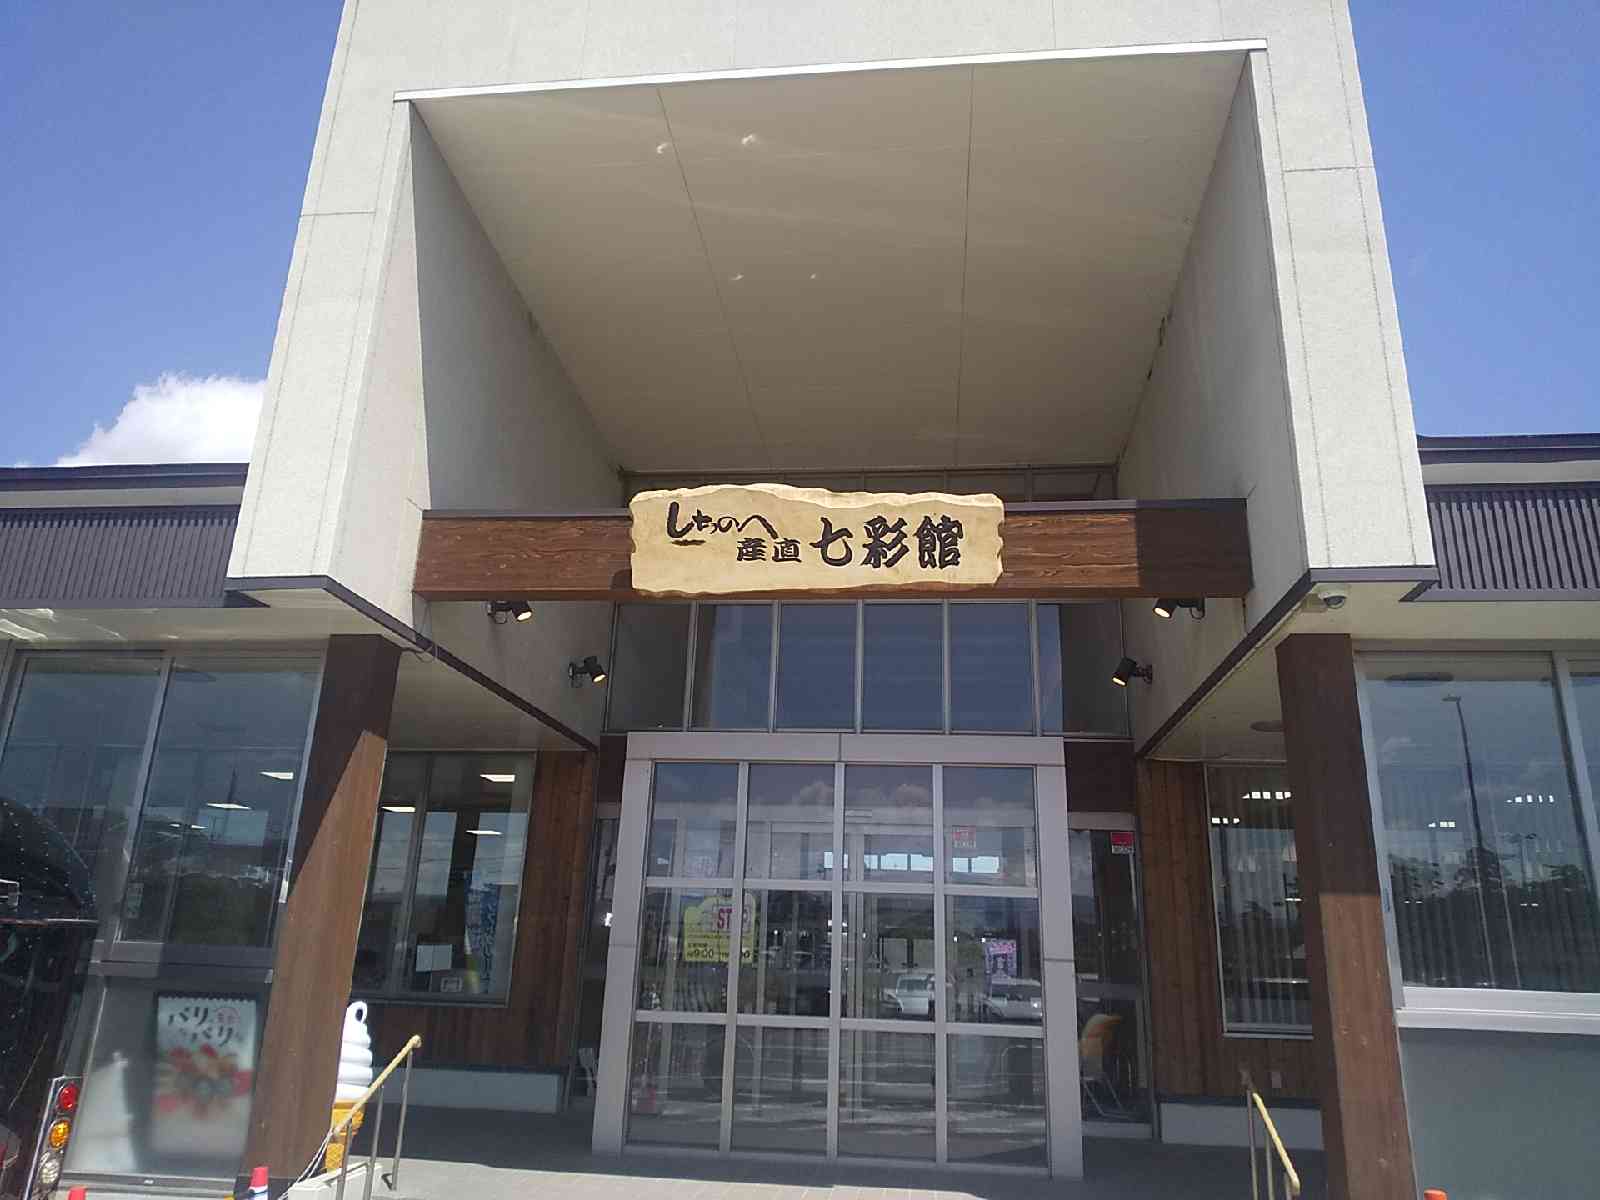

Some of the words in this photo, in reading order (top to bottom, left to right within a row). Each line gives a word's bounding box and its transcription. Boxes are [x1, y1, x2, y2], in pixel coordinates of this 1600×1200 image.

[736, 537, 802, 563] 産直
[809, 515, 964, 569] 七彩館
